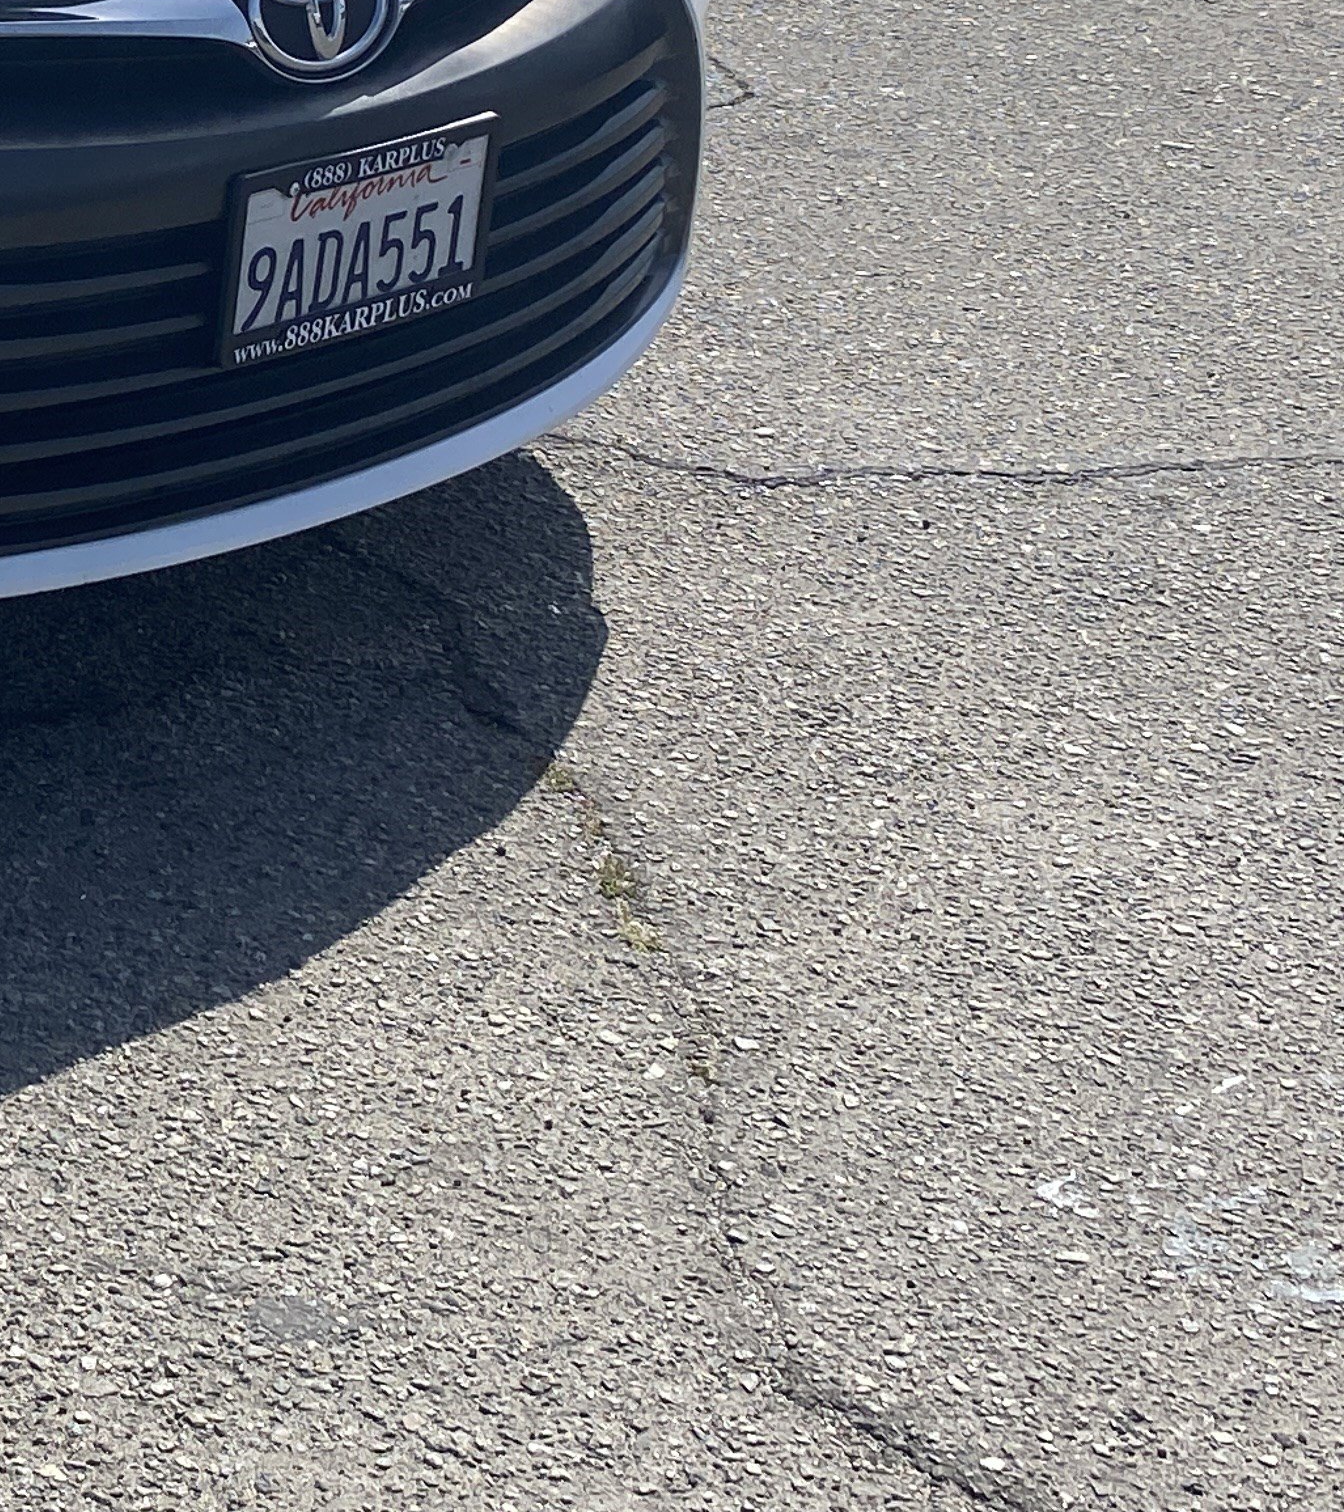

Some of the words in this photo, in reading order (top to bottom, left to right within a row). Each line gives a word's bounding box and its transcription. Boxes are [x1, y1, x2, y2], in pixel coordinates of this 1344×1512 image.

[302, 161, 354, 191] (888)
[357, 136, 448, 179] KARPLUS
[289, 164, 448, 223] California
[240, 193, 466, 334] 9ADA551
